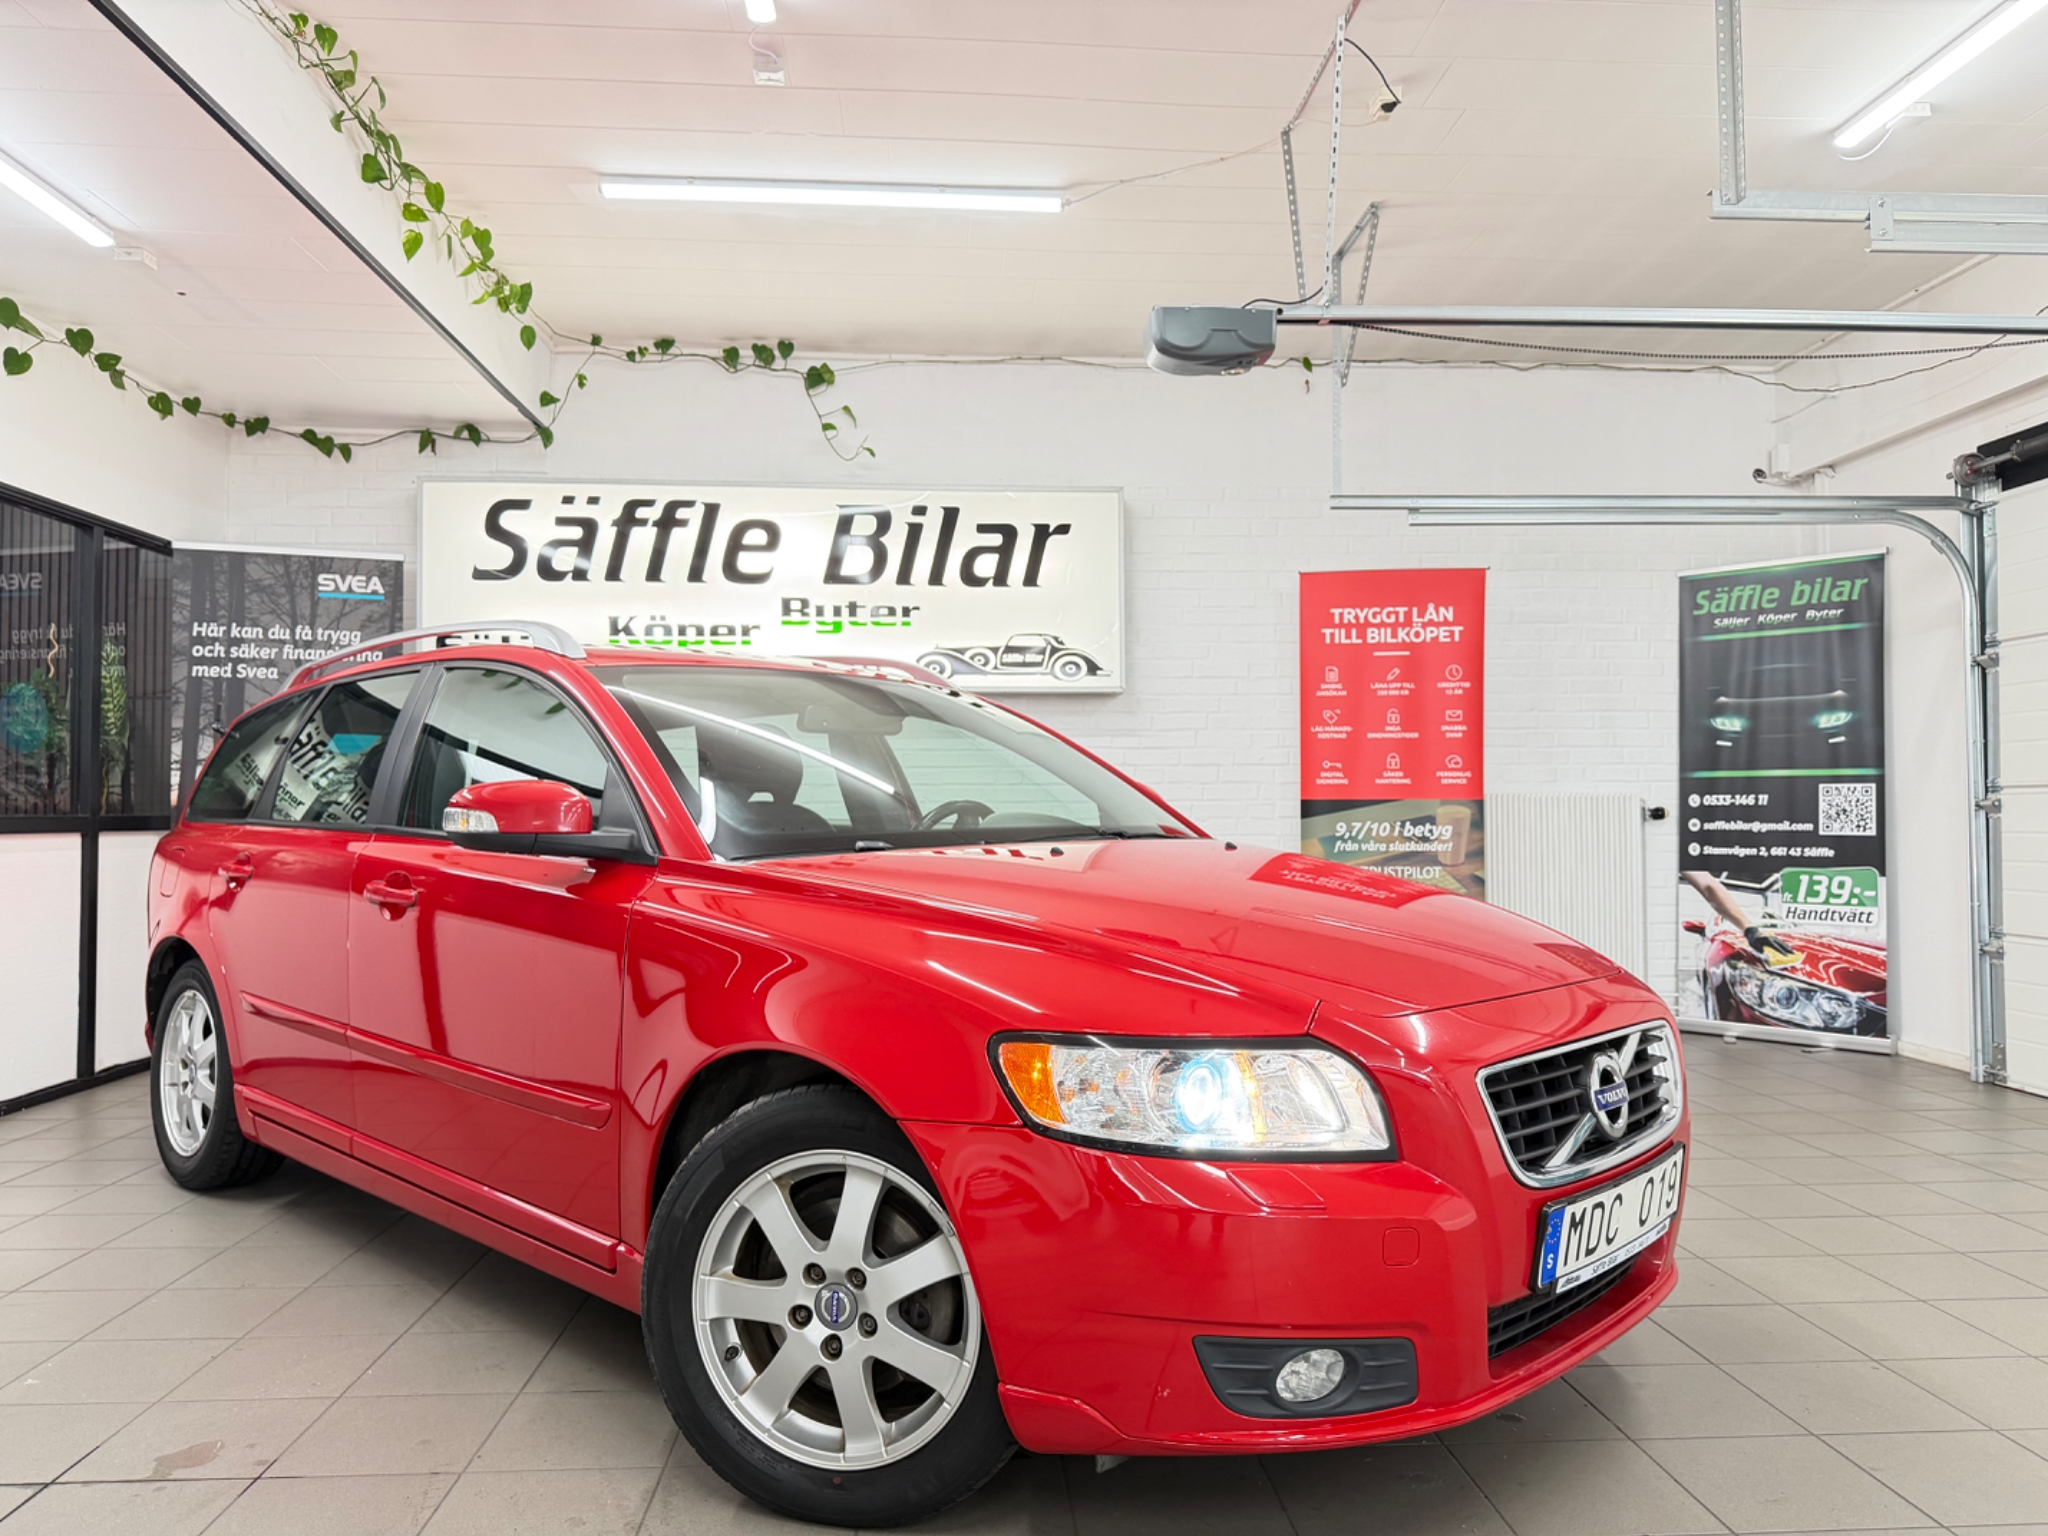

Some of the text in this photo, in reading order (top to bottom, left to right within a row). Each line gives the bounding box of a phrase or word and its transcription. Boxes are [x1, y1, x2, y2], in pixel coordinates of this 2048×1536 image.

[472, 495, 1072, 588] Säffle Bilar
[317, 573, 385, 594] SVEA
[1692, 576, 1869, 615] Säffle bilar
[781, 597, 920, 634] Byter
[1330, 602, 1454, 624] TRYGGT LÅN
[1757, 612, 1797, 625] Köper
[1805, 608, 1844, 621] Byter
[192, 621, 361, 645] Här kan du få trygg
[608, 615, 760, 647] Köper
[1321, 622, 1464, 644] TILL BILKÖPET
[191, 641, 226, 658] och
[229, 643, 279, 659] säker
[191, 662, 279, 679] med Svea
[1703, 794, 1756, 806] 0533-146
[1335, 821, 1453, 839] 9,7/10 i betyg
[1334, 840, 1453, 853] från våra slutkunder!
[1797, 874, 1876, 905] 139:-
[1786, 906, 1874, 924] Handtvätt
[1597, 1088, 1627, 1104] VOLVO
[1547, 1160, 1678, 1269] S MDC 019
